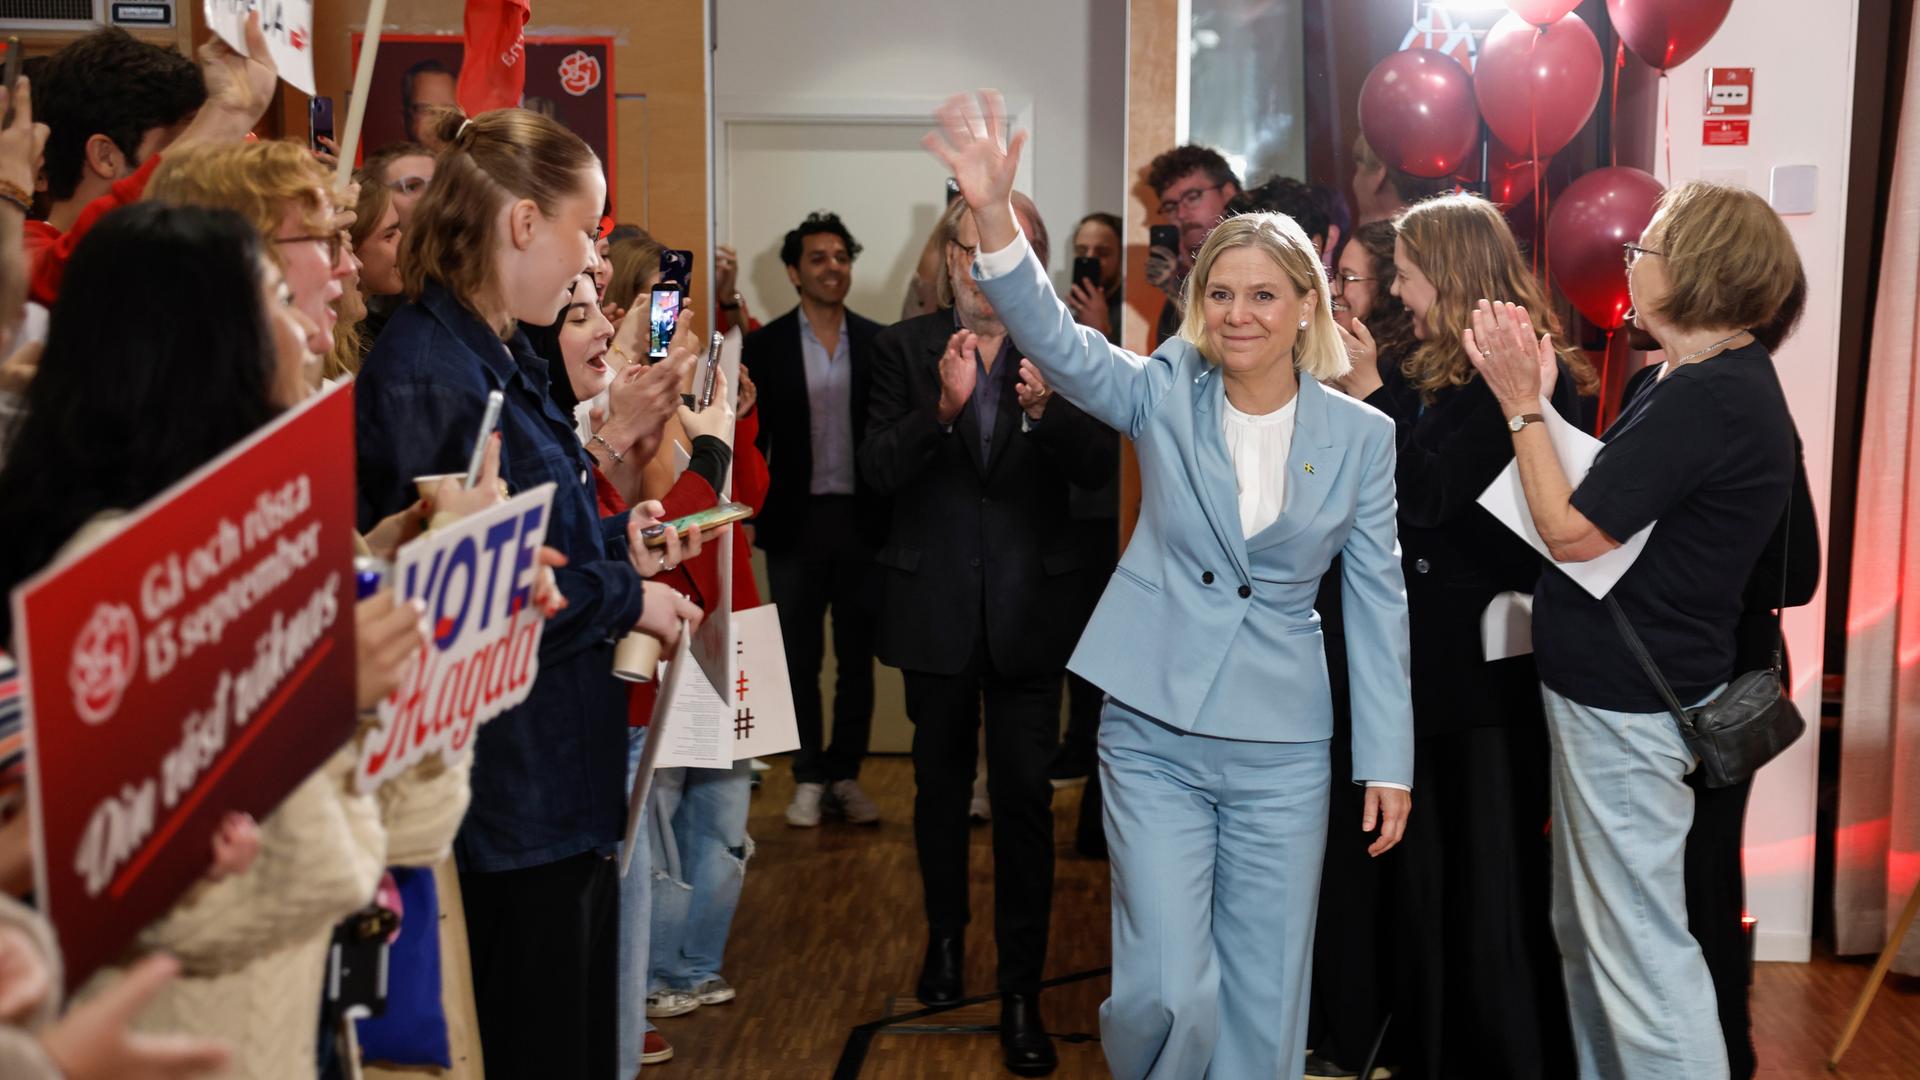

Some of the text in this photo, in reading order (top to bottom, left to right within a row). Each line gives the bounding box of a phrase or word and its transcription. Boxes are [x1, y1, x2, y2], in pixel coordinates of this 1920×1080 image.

[180, 521, 321, 658] september
[186, 518, 241, 590] och
[405, 504, 544, 652] VOTE
[366, 597, 538, 776] Magda
